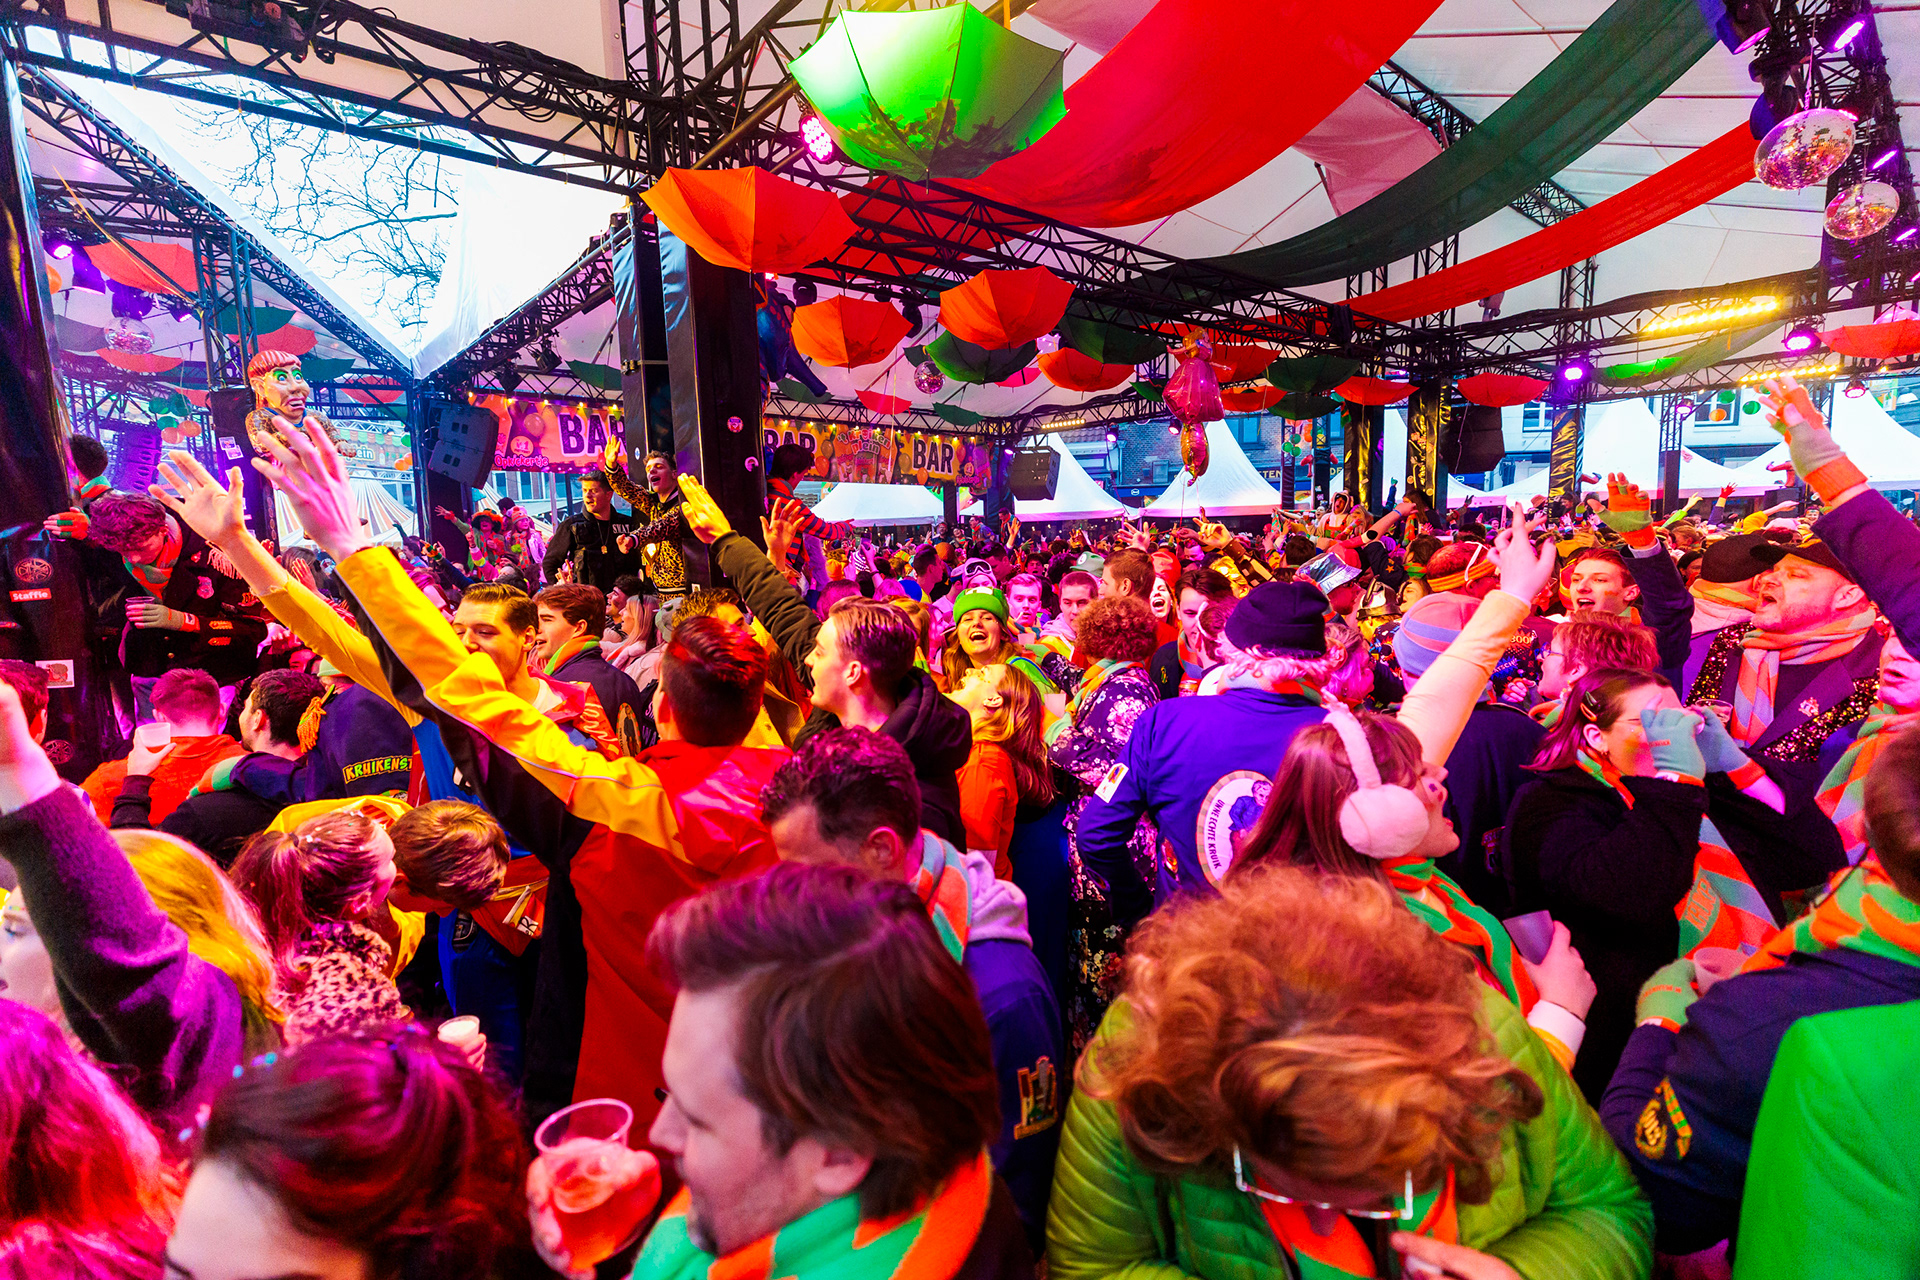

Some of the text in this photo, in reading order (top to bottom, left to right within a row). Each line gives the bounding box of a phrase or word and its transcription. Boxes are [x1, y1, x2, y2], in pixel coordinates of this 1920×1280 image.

[558, 412, 627, 456] BAR
[851, 440, 880, 455] plein
[912, 438, 954, 475] BAR
[12, 591, 49, 601] Staffie
[1207, 817, 1218, 841] ECHTE
[1208, 843, 1222, 870] KRUIK
